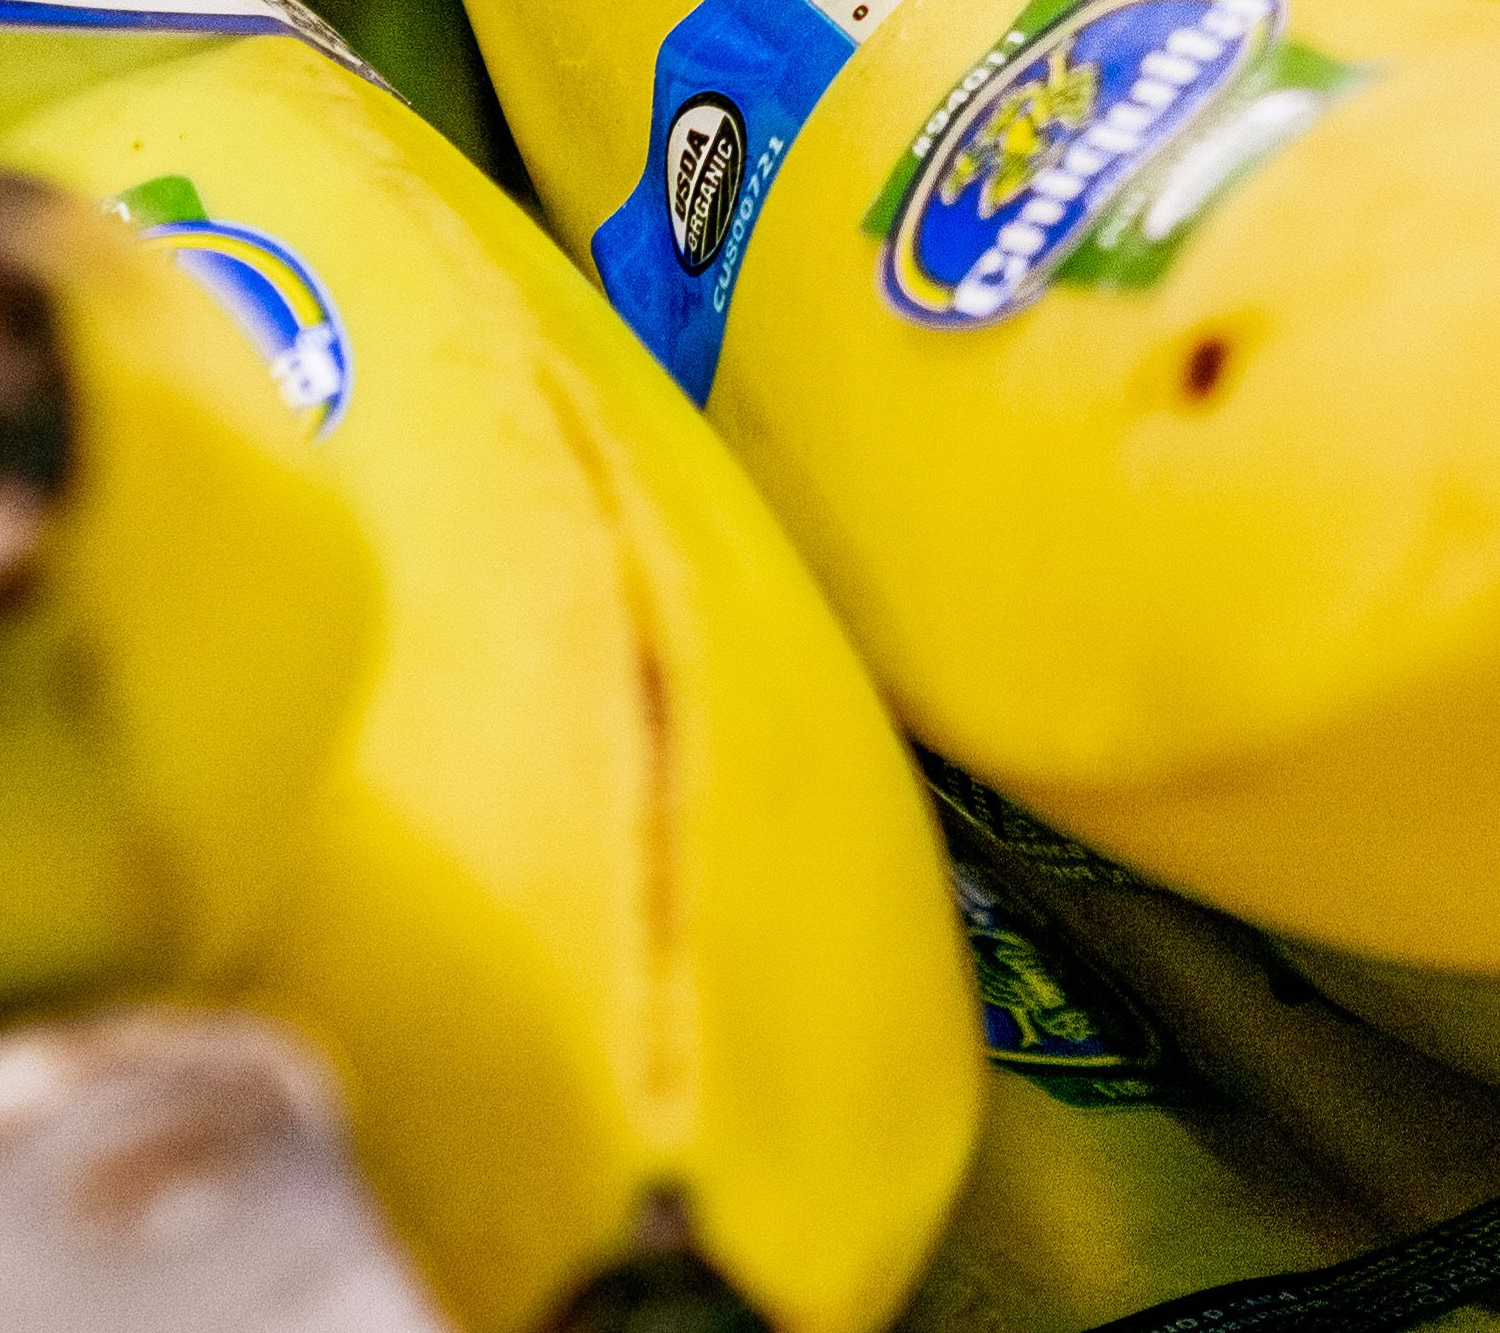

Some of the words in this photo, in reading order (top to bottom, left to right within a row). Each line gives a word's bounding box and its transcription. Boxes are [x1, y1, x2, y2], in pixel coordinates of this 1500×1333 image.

[852, 4, 869, 22] 0
[675, 129, 710, 222] USDA
[687, 137, 733, 252] ORGANIC
[713, 136, 785, 313] CUS00721
